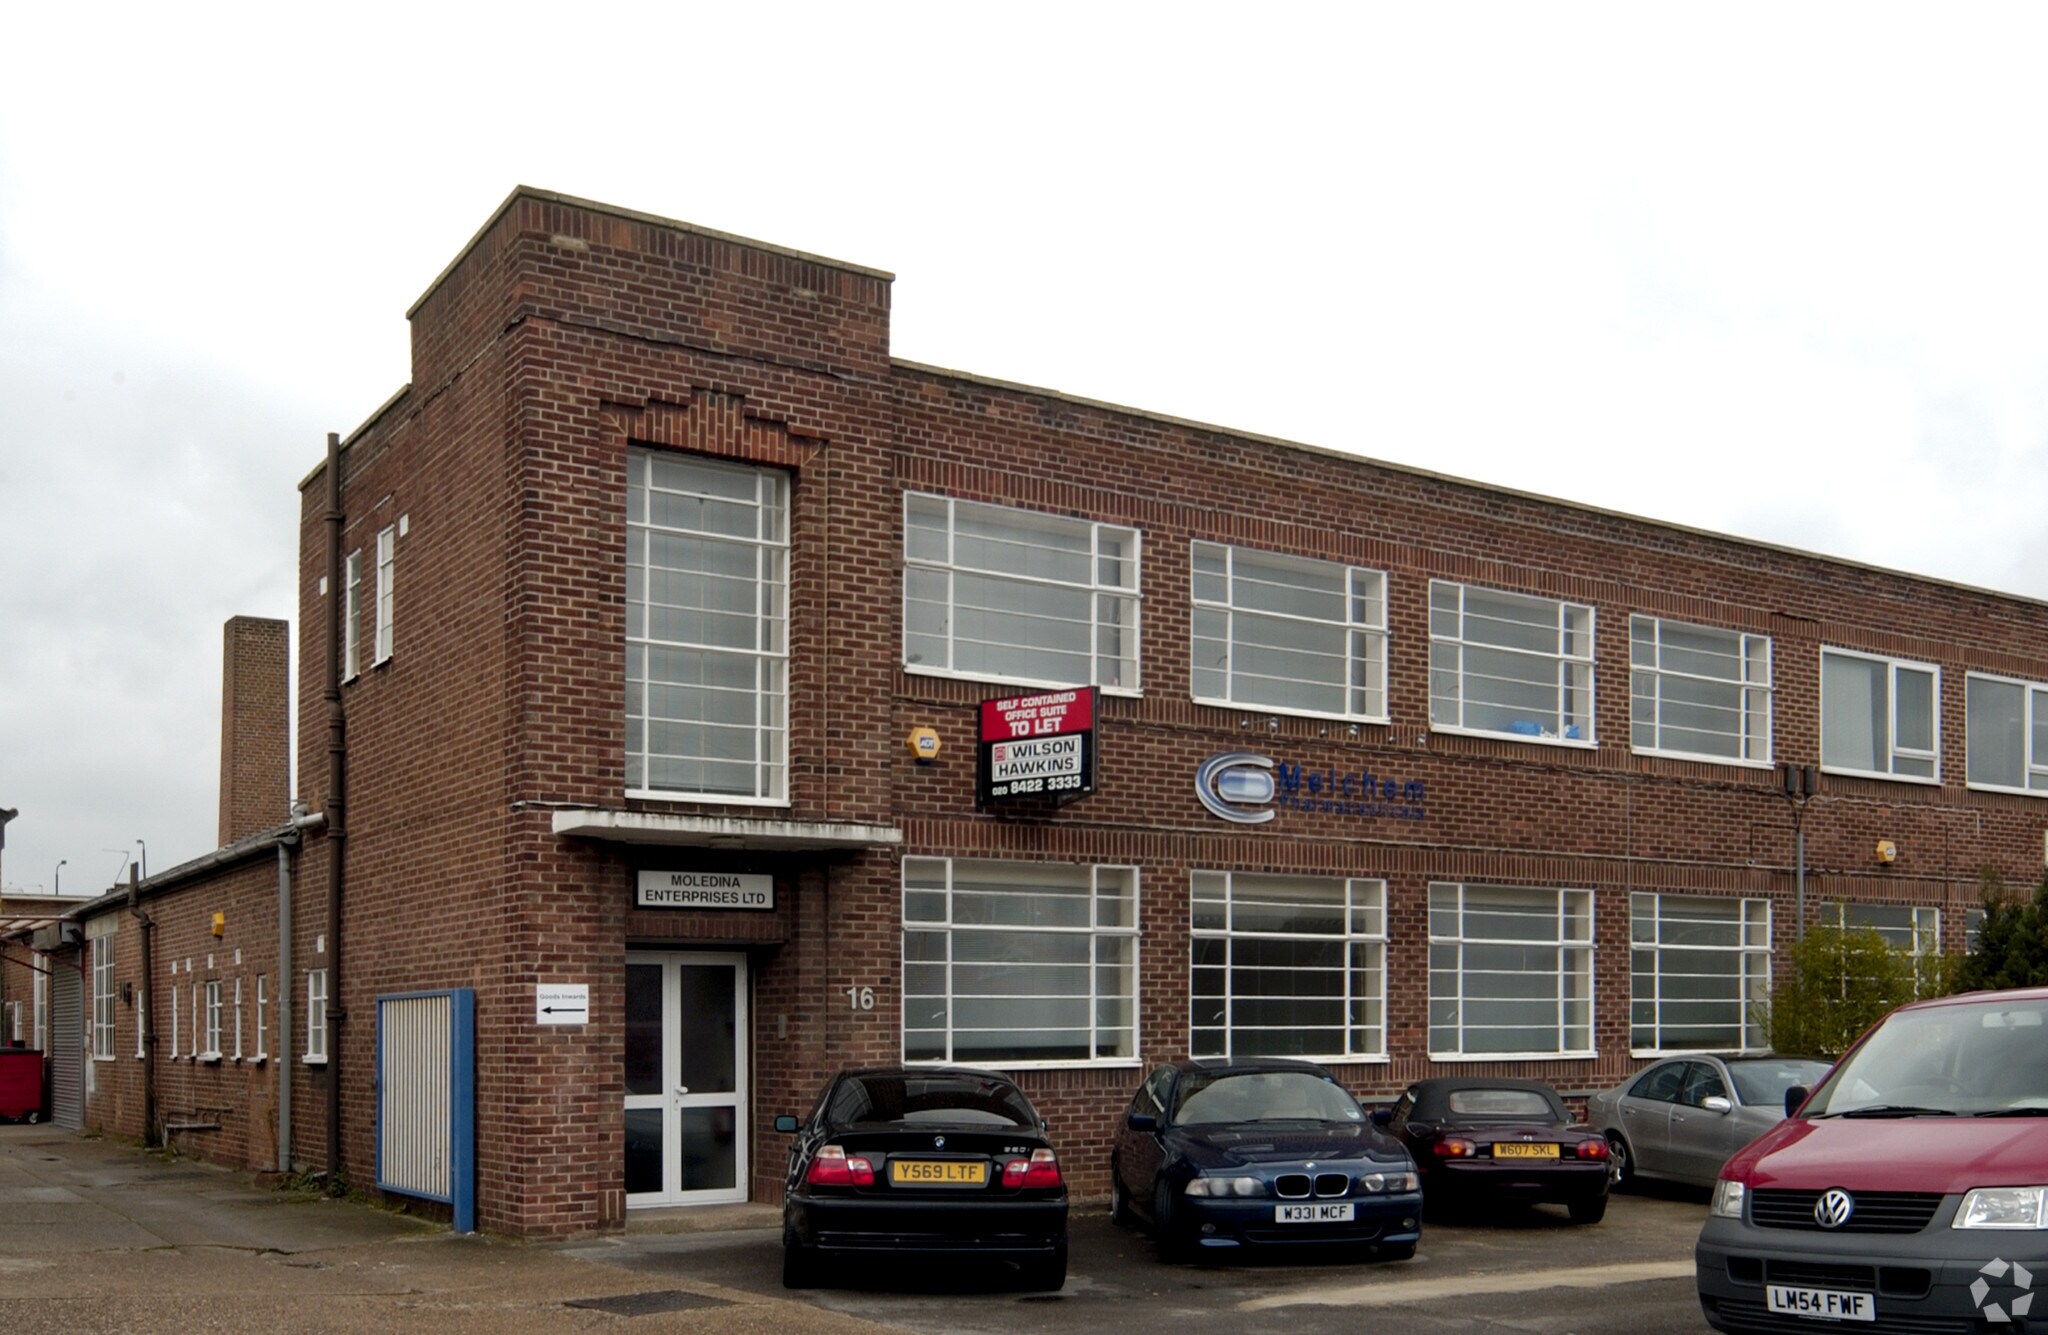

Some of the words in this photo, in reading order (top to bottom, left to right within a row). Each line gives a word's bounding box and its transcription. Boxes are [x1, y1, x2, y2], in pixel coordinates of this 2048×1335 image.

[996, 699, 1019, 711] SELF
[1021, 692, 1076, 708] CONTAINED
[1005, 708, 1037, 721] OFFICE
[1040, 705, 1067, 717] SUITE
[1009, 720, 1030, 736] TO
[1035, 717, 1062, 734] LET
[1012, 740, 1075, 758] WILSON
[999, 757, 1074, 776] HAWKINS
[992, 786, 1008, 796] 020
[1011, 779, 1043, 794] 8422
[1047, 775, 1081, 790] 3333
[1279, 761, 1424, 801] Melchem
[671, 874, 741, 888] MOLEDINA
[645, 889, 739, 904] ENTERPRISES
[742, 892, 766, 904] LTD
[846, 986, 874, 1010] 16
[1500, 1144, 1529, 1156] W607
[1532, 1144, 1554, 1156] SKL
[901, 1164, 942, 1179] Y569
[947, 1165, 977, 1180] LTF
[1284, 1206, 1315, 1220] W331
[1320, 1205, 1347, 1219] MCF
[1774, 1289, 1821, 1311] LM54
[1827, 1293, 1864, 1315] FWF
